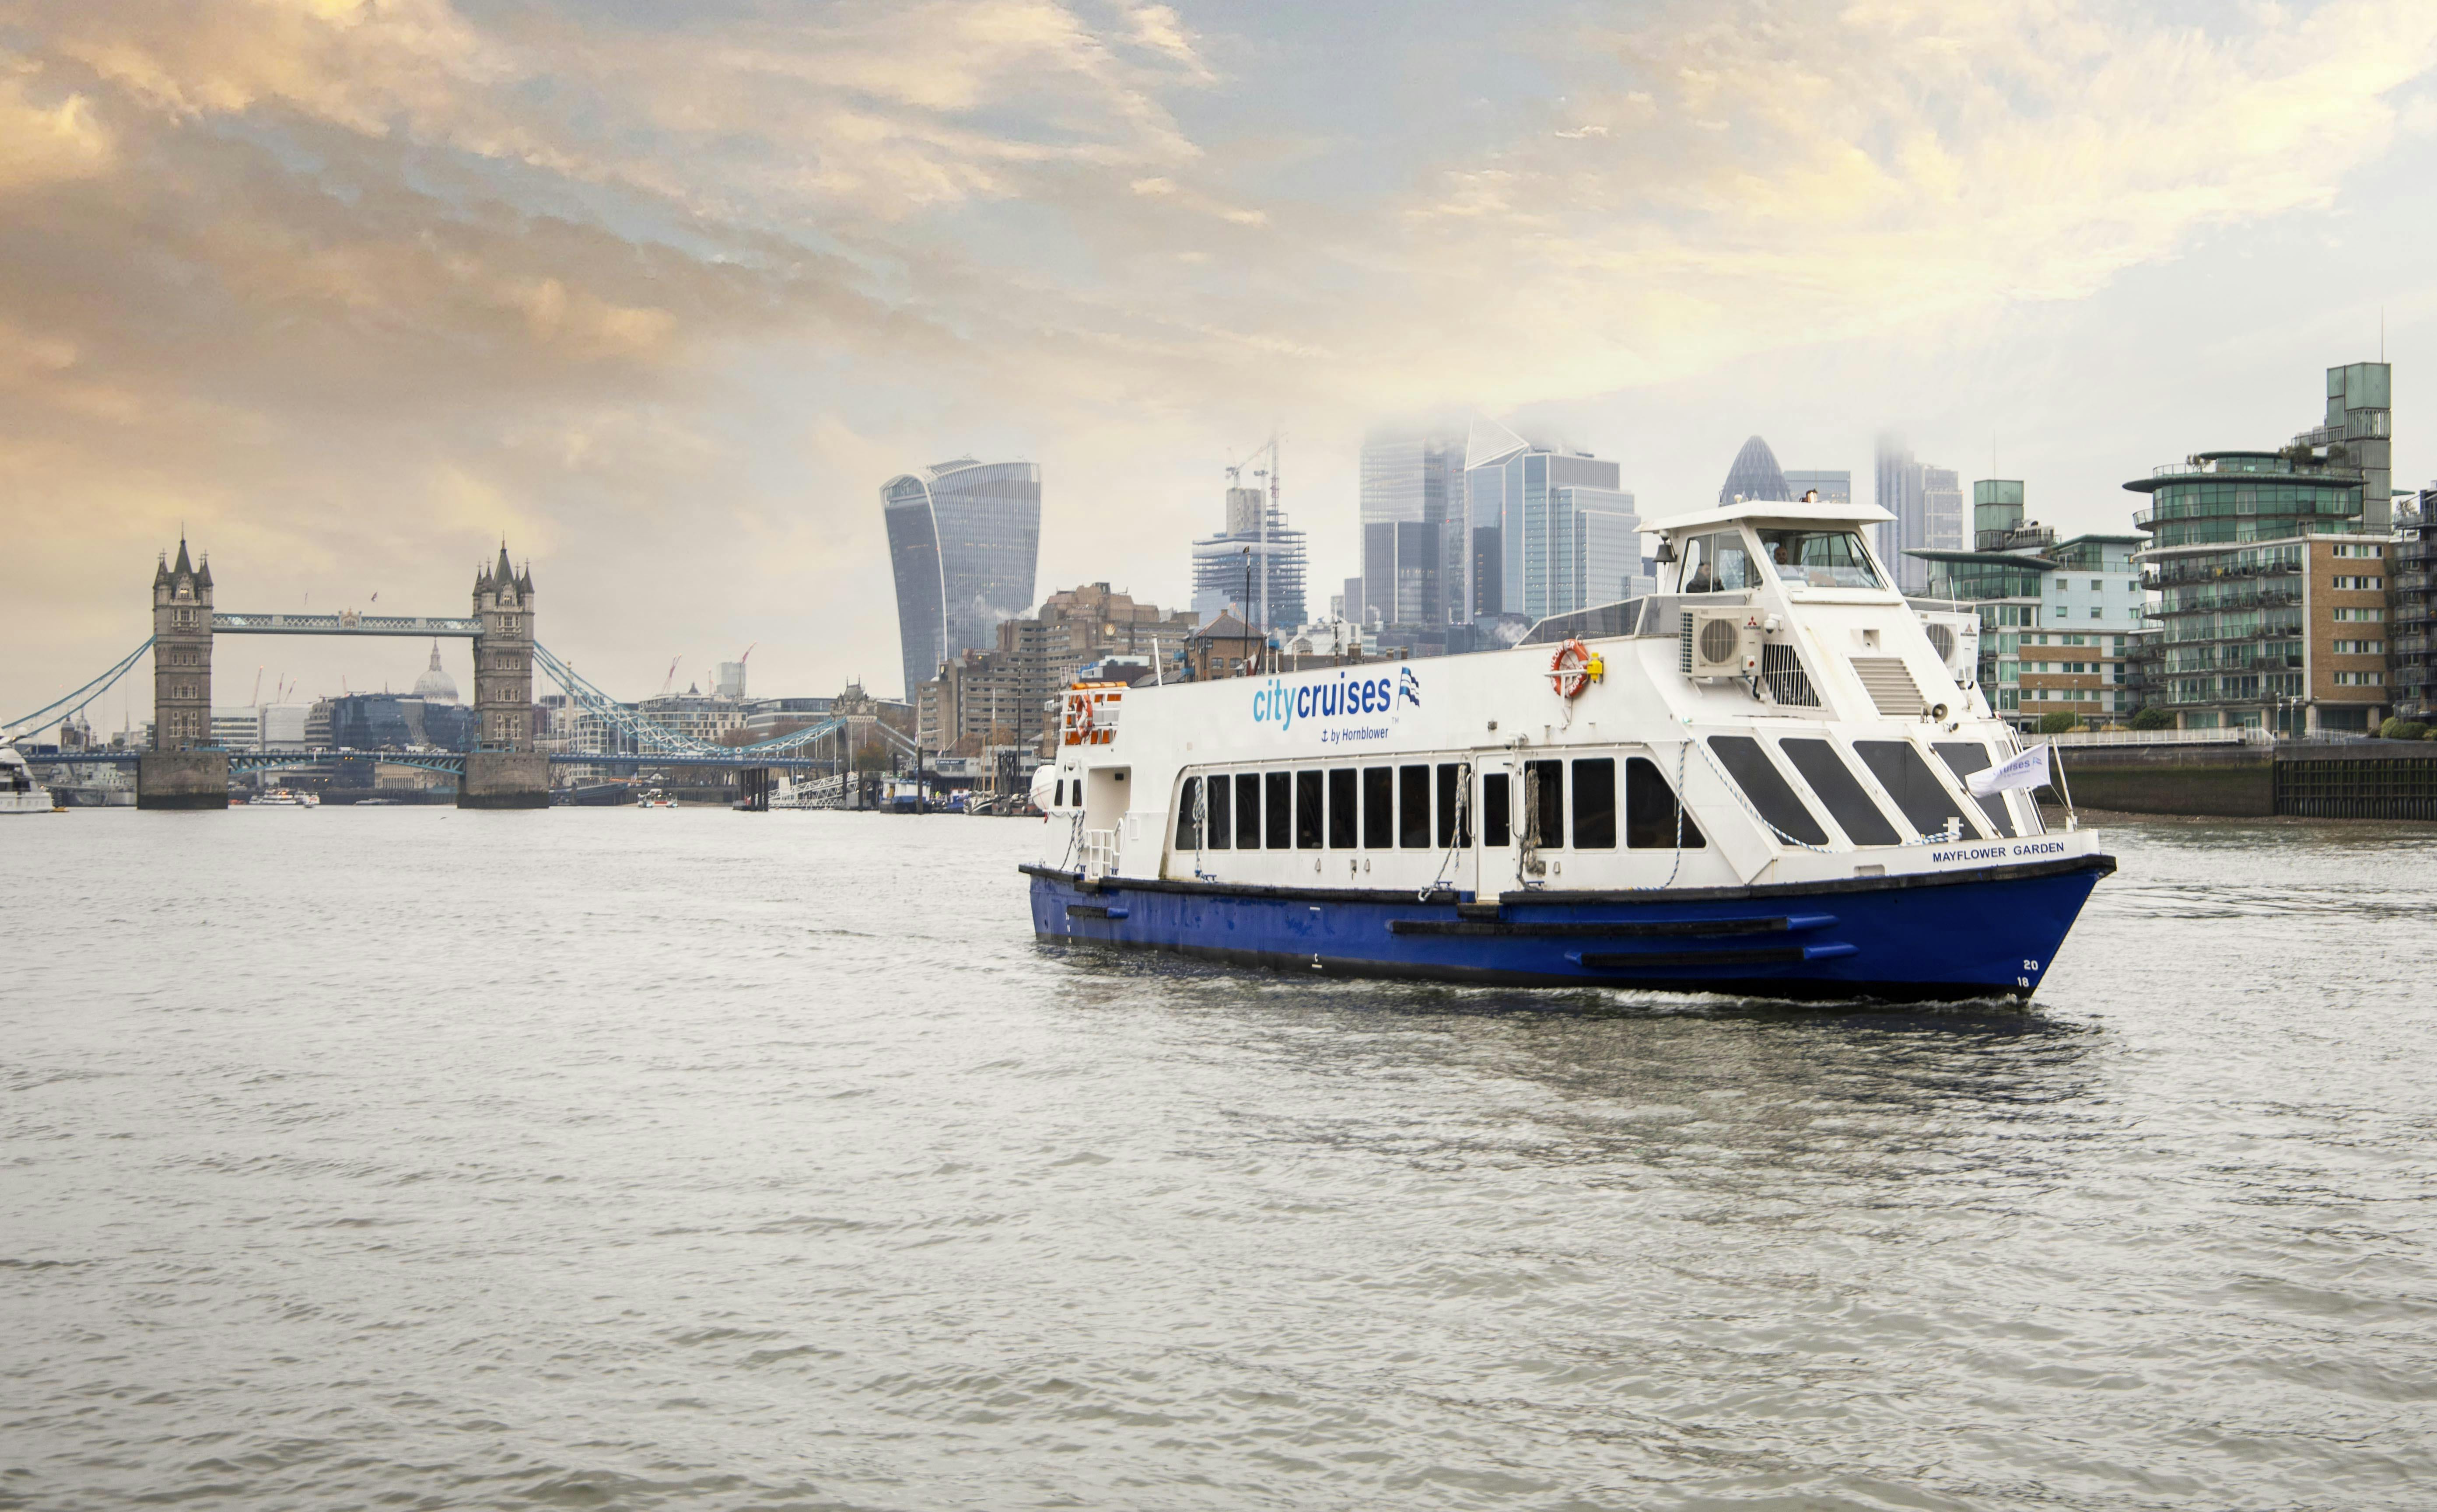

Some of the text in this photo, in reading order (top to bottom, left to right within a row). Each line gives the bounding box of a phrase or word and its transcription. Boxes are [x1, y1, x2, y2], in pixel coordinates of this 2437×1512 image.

[1254, 672, 1391, 731] citycruises
[1331, 726, 1389, 745] by Hornblower
[1933, 841, 2064, 862] MAYFLOWER GARDEN
[2024, 959, 2038, 970] 20
[2017, 976, 2029, 987] 18
